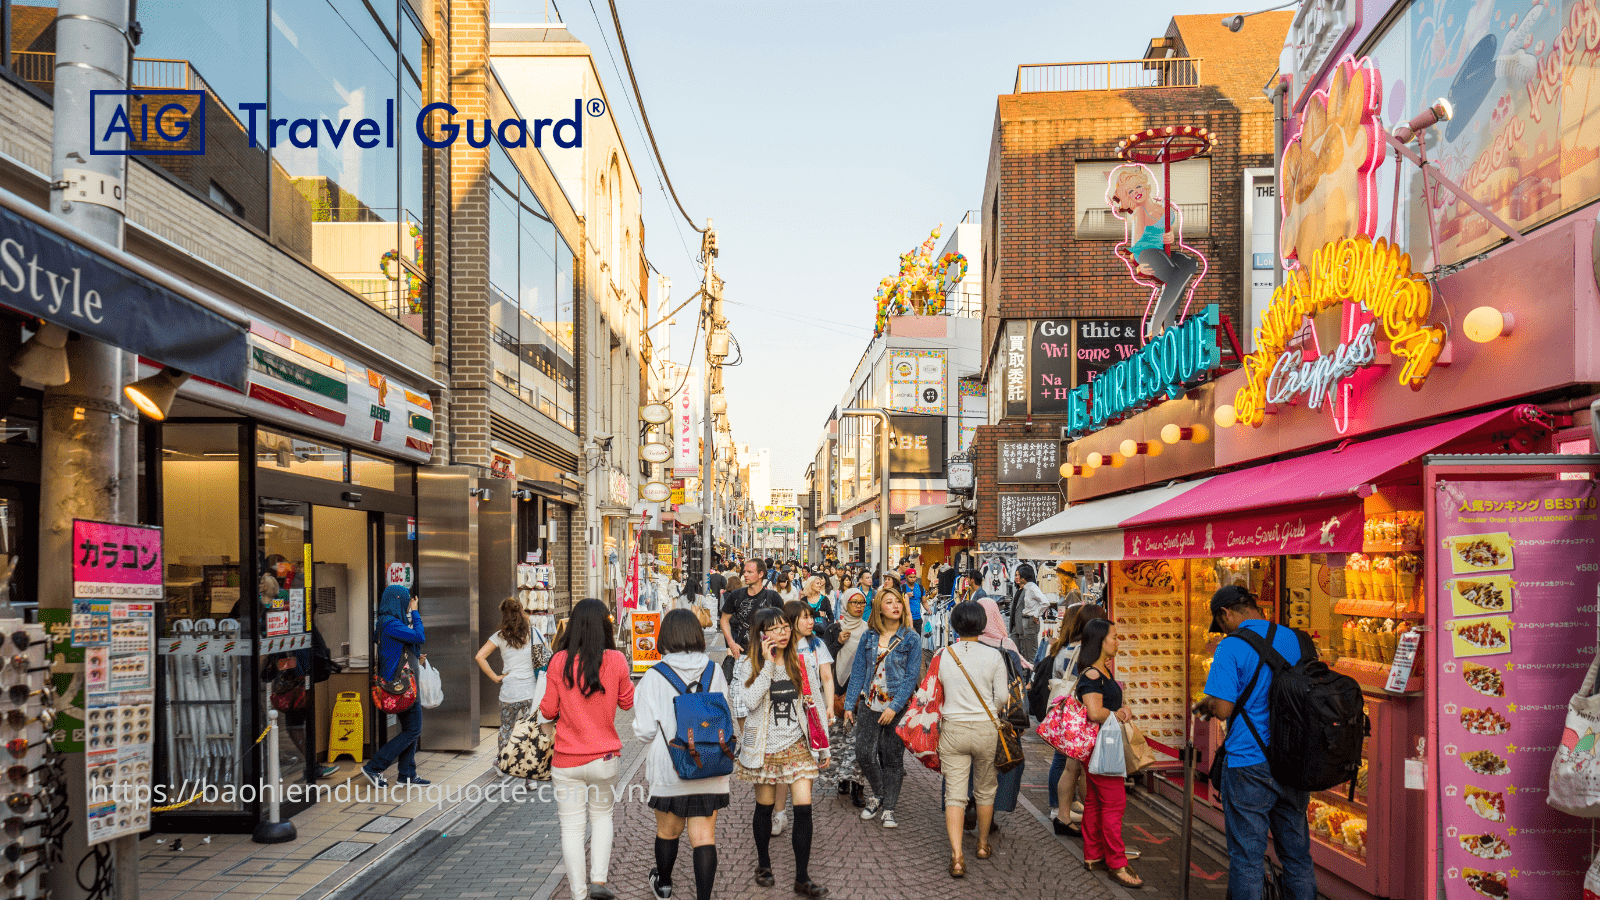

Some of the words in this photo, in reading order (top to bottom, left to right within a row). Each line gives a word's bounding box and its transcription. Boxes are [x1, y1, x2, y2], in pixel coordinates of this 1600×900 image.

[1256, 186, 1274, 198] THE
[0, 238, 104, 324] Style
[1007, 335, 1025, 401] 買取委託
[1092, 304, 1220, 427] BURLESQUE
[1458, 499, 1541, 512] 人気ランキング
[1544, 497, 1598, 510] BEST10
[1180, 530, 1195, 555] Girls
[1227, 530, 1247, 547] Come
[1255, 522, 1279, 545] Sweet
[1280, 517, 1306, 550] Girls
[81, 539, 158, 571] カラコン
[1576, 563, 1599, 572] ¥580
[116, 586, 144, 595] CONTACT
